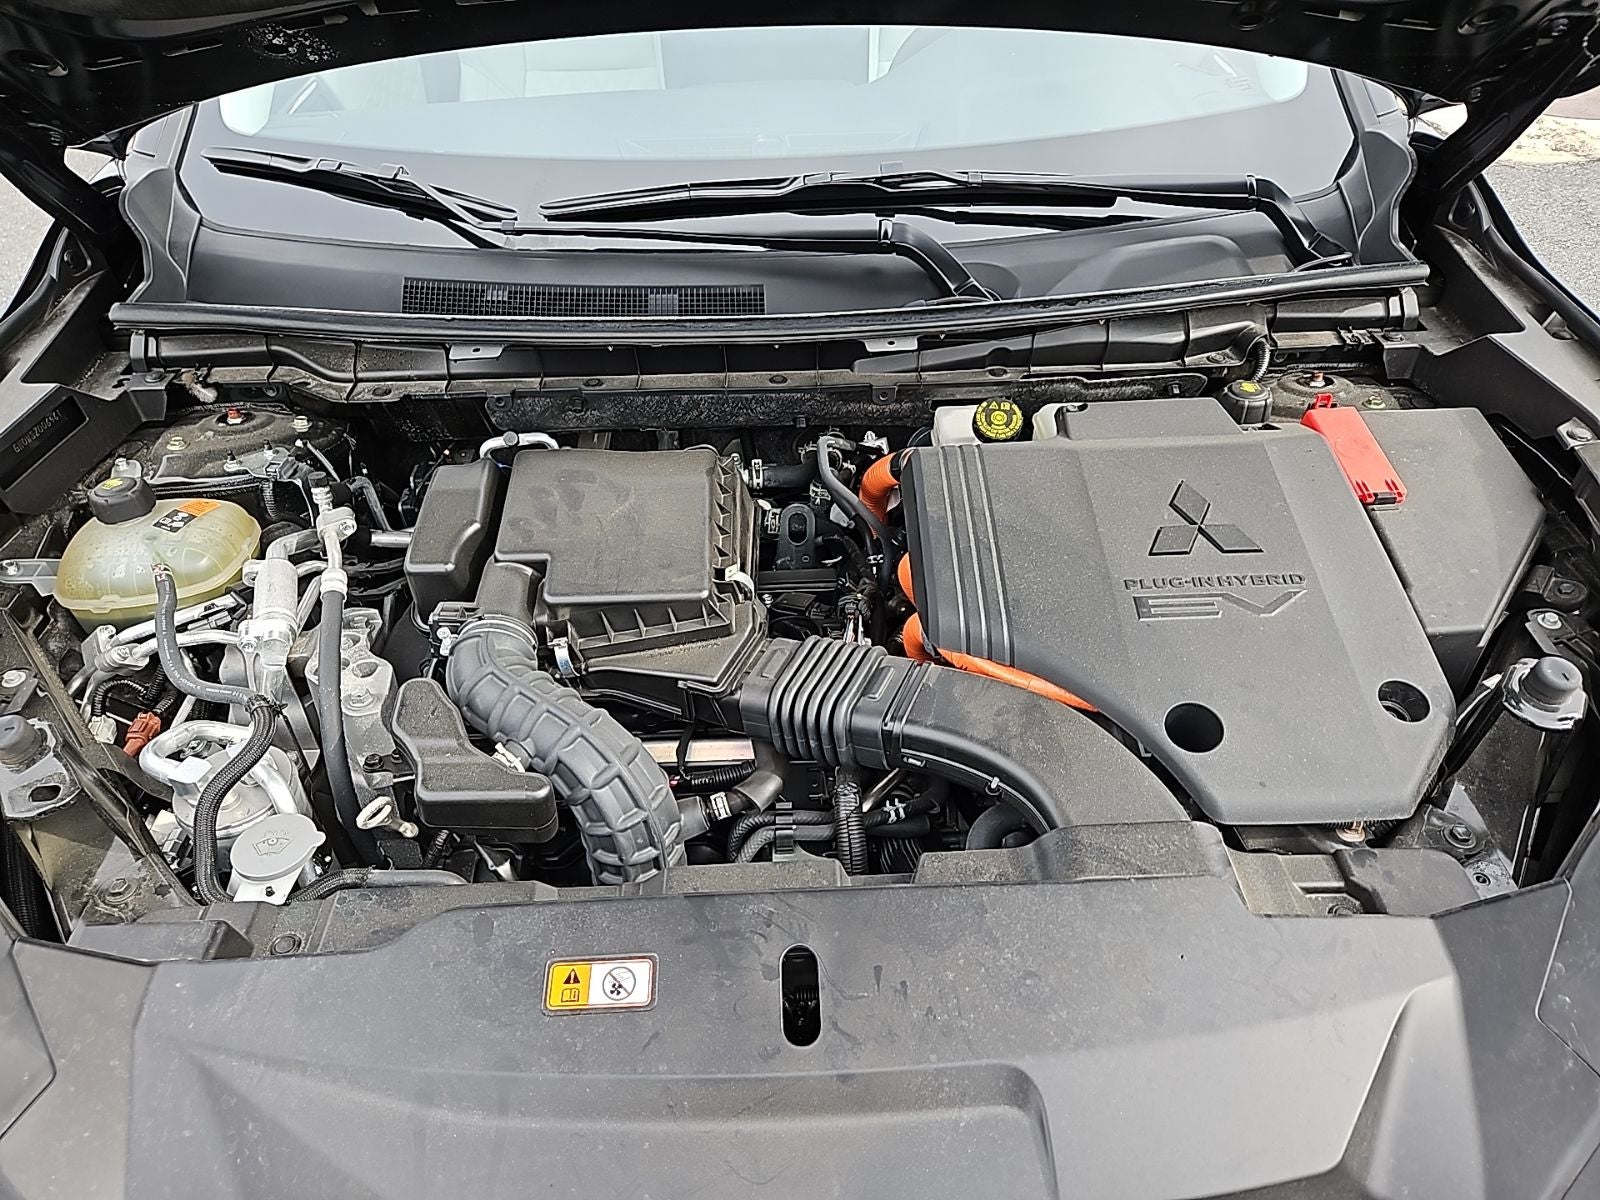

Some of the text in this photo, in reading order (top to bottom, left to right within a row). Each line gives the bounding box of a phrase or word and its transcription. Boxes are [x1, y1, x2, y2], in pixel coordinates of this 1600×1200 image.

[1123, 573, 1306, 591] PLUG-IN HYBRID
[1132, 589, 1308, 622] EV
